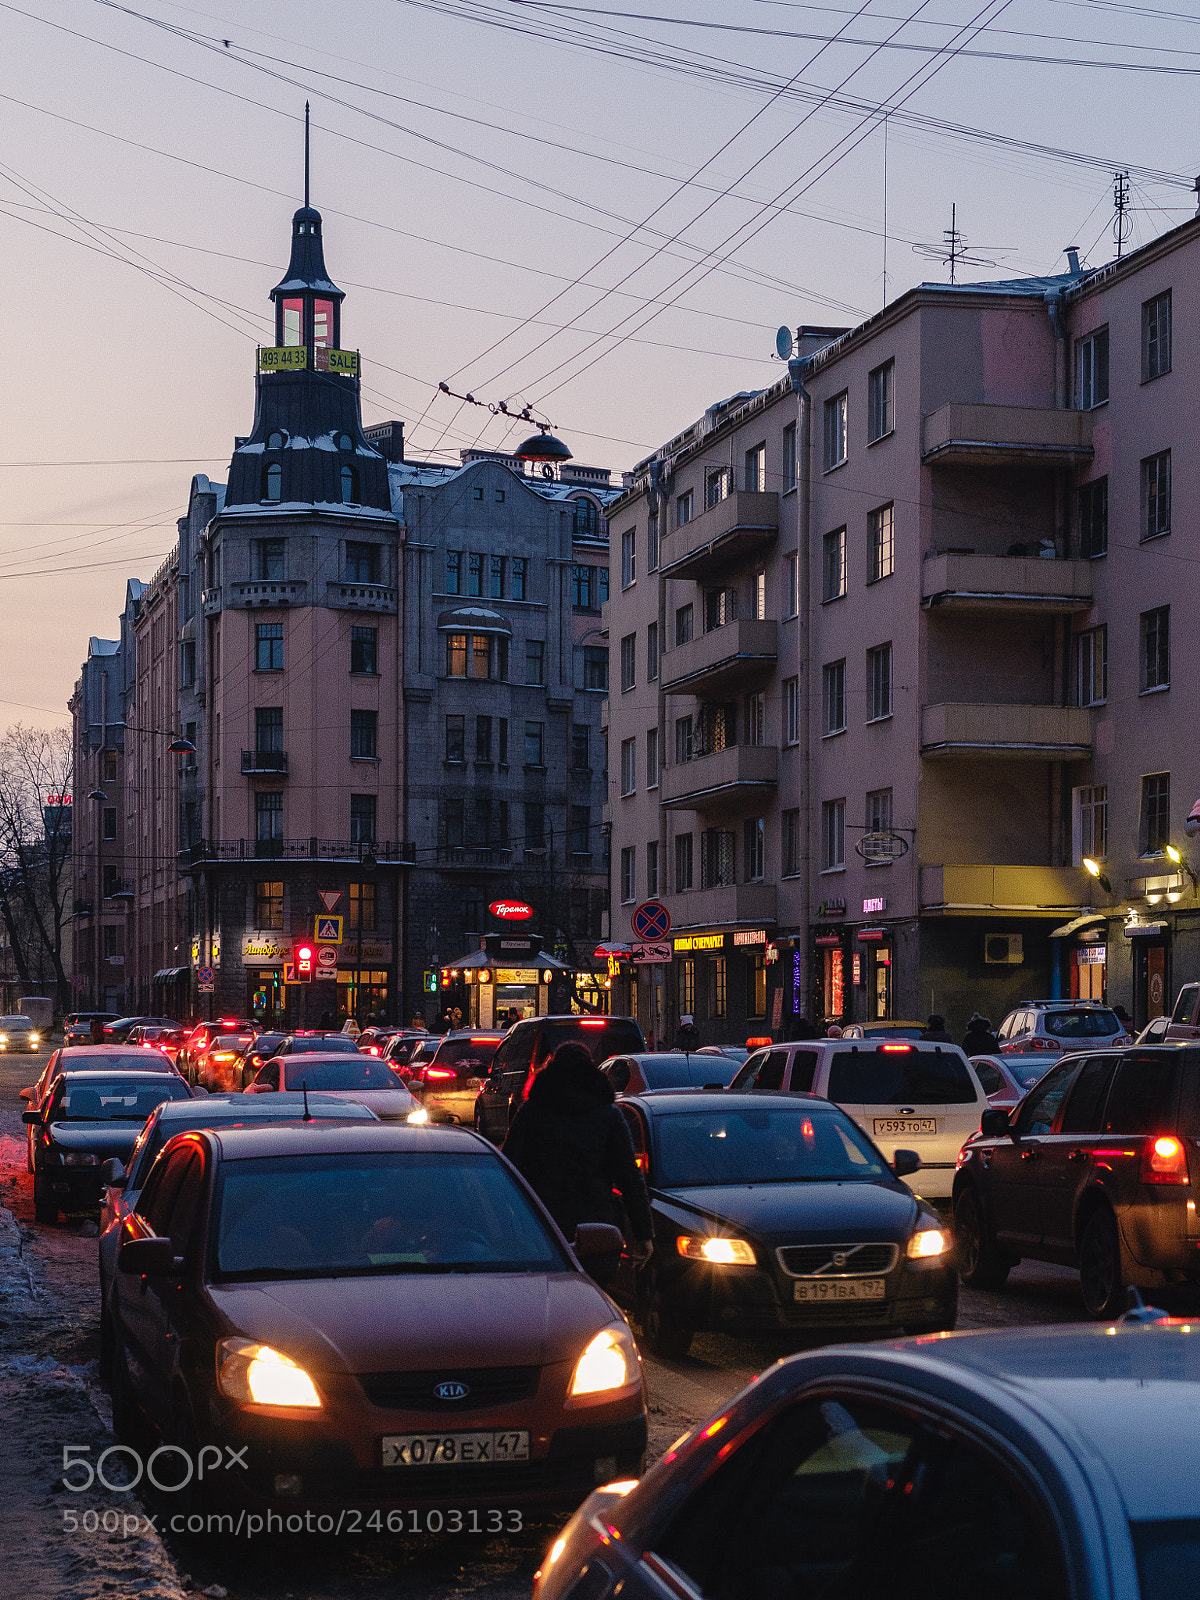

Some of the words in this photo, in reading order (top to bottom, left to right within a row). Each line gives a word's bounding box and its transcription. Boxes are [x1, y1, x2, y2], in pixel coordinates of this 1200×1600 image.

[263, 352, 278, 365] 493
[281, 351, 292, 364] 44
[295, 350, 305, 364] 33
[330, 354, 356, 369] SALE
[496, 904, 529, 916] Теремок
[922, 1121, 932, 1129] 47
[439, 1385, 464, 1396] KIA
[497, 1433, 520, 1452] 47
